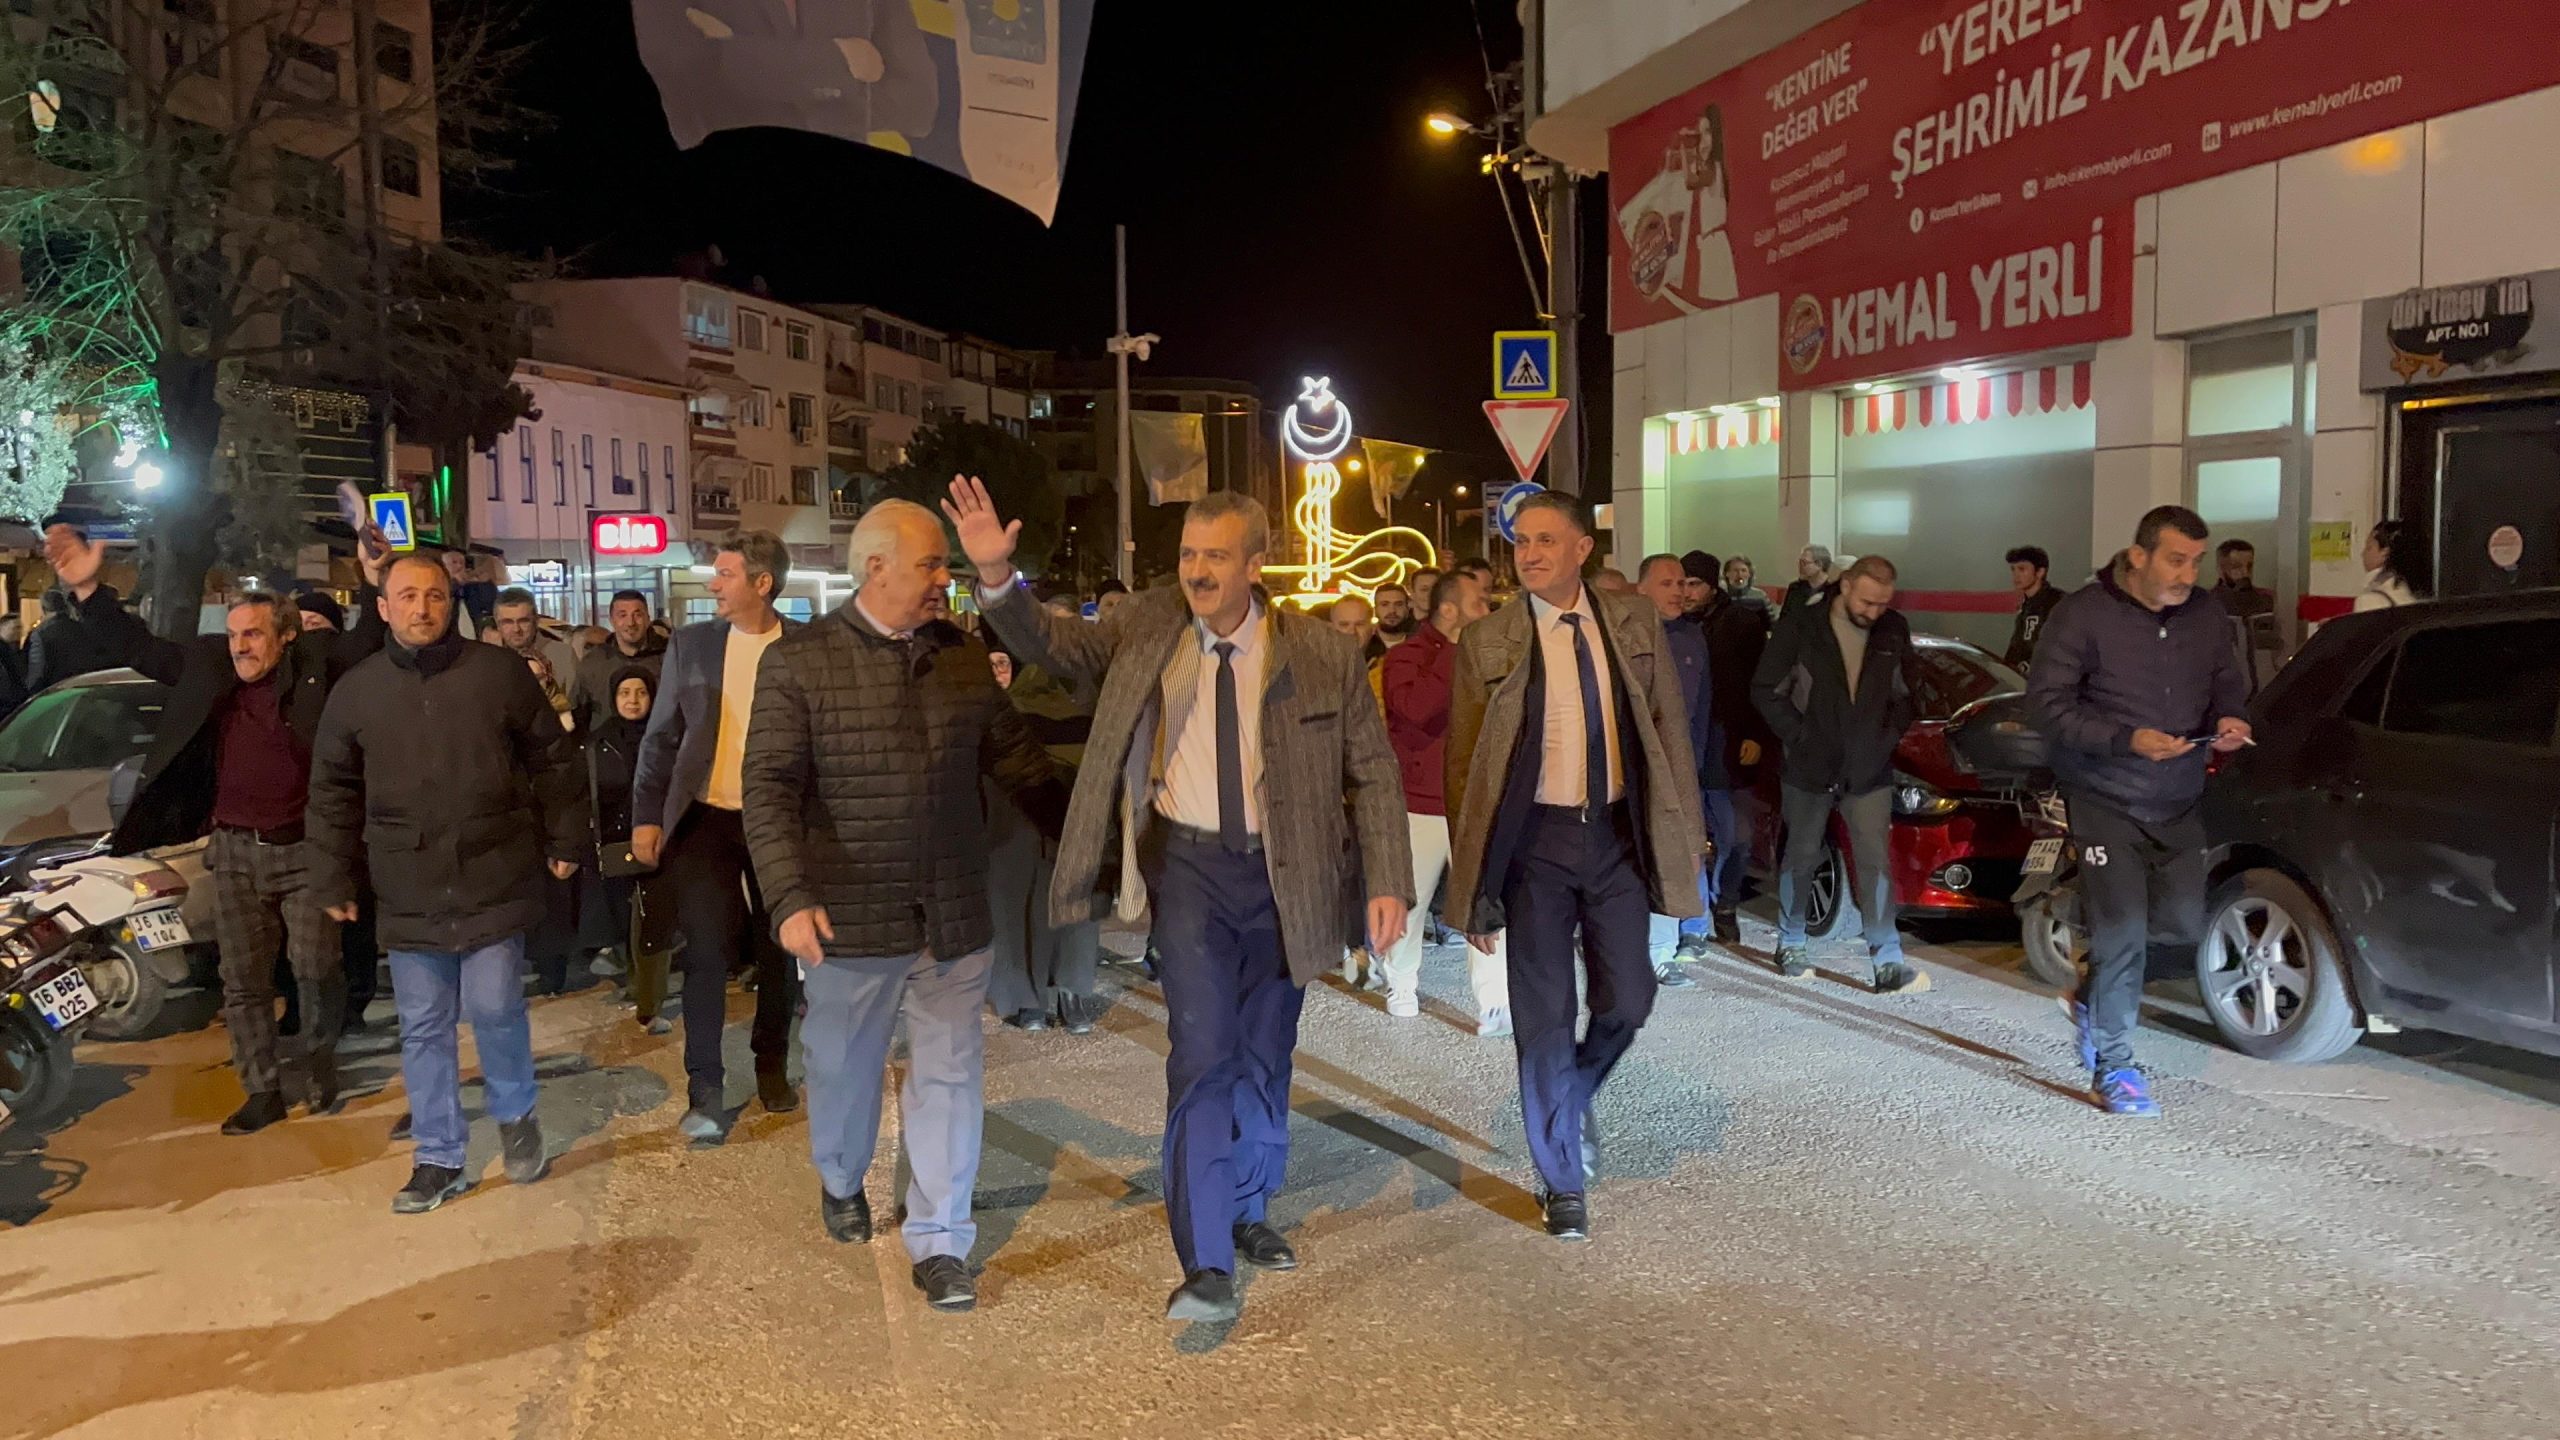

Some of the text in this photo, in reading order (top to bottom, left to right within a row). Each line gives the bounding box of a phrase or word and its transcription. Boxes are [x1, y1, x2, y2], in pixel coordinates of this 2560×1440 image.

[1890, 42, 2092, 199] ŞEHRİMİZ
[2229, 74, 2404, 139] www.kemalyerli.com
[1762, 105, 1819, 160] DEĞER
[1831, 271, 1958, 360] KEMAL
[1970, 217, 2104, 332] YERLİ
[600, 517, 658, 549] BİM
[2085, 845, 2108, 867] 45
[135, 915, 153, 932] 16
[33, 970, 85, 1009] 16 BBZ
[59, 994, 88, 1021] 025
